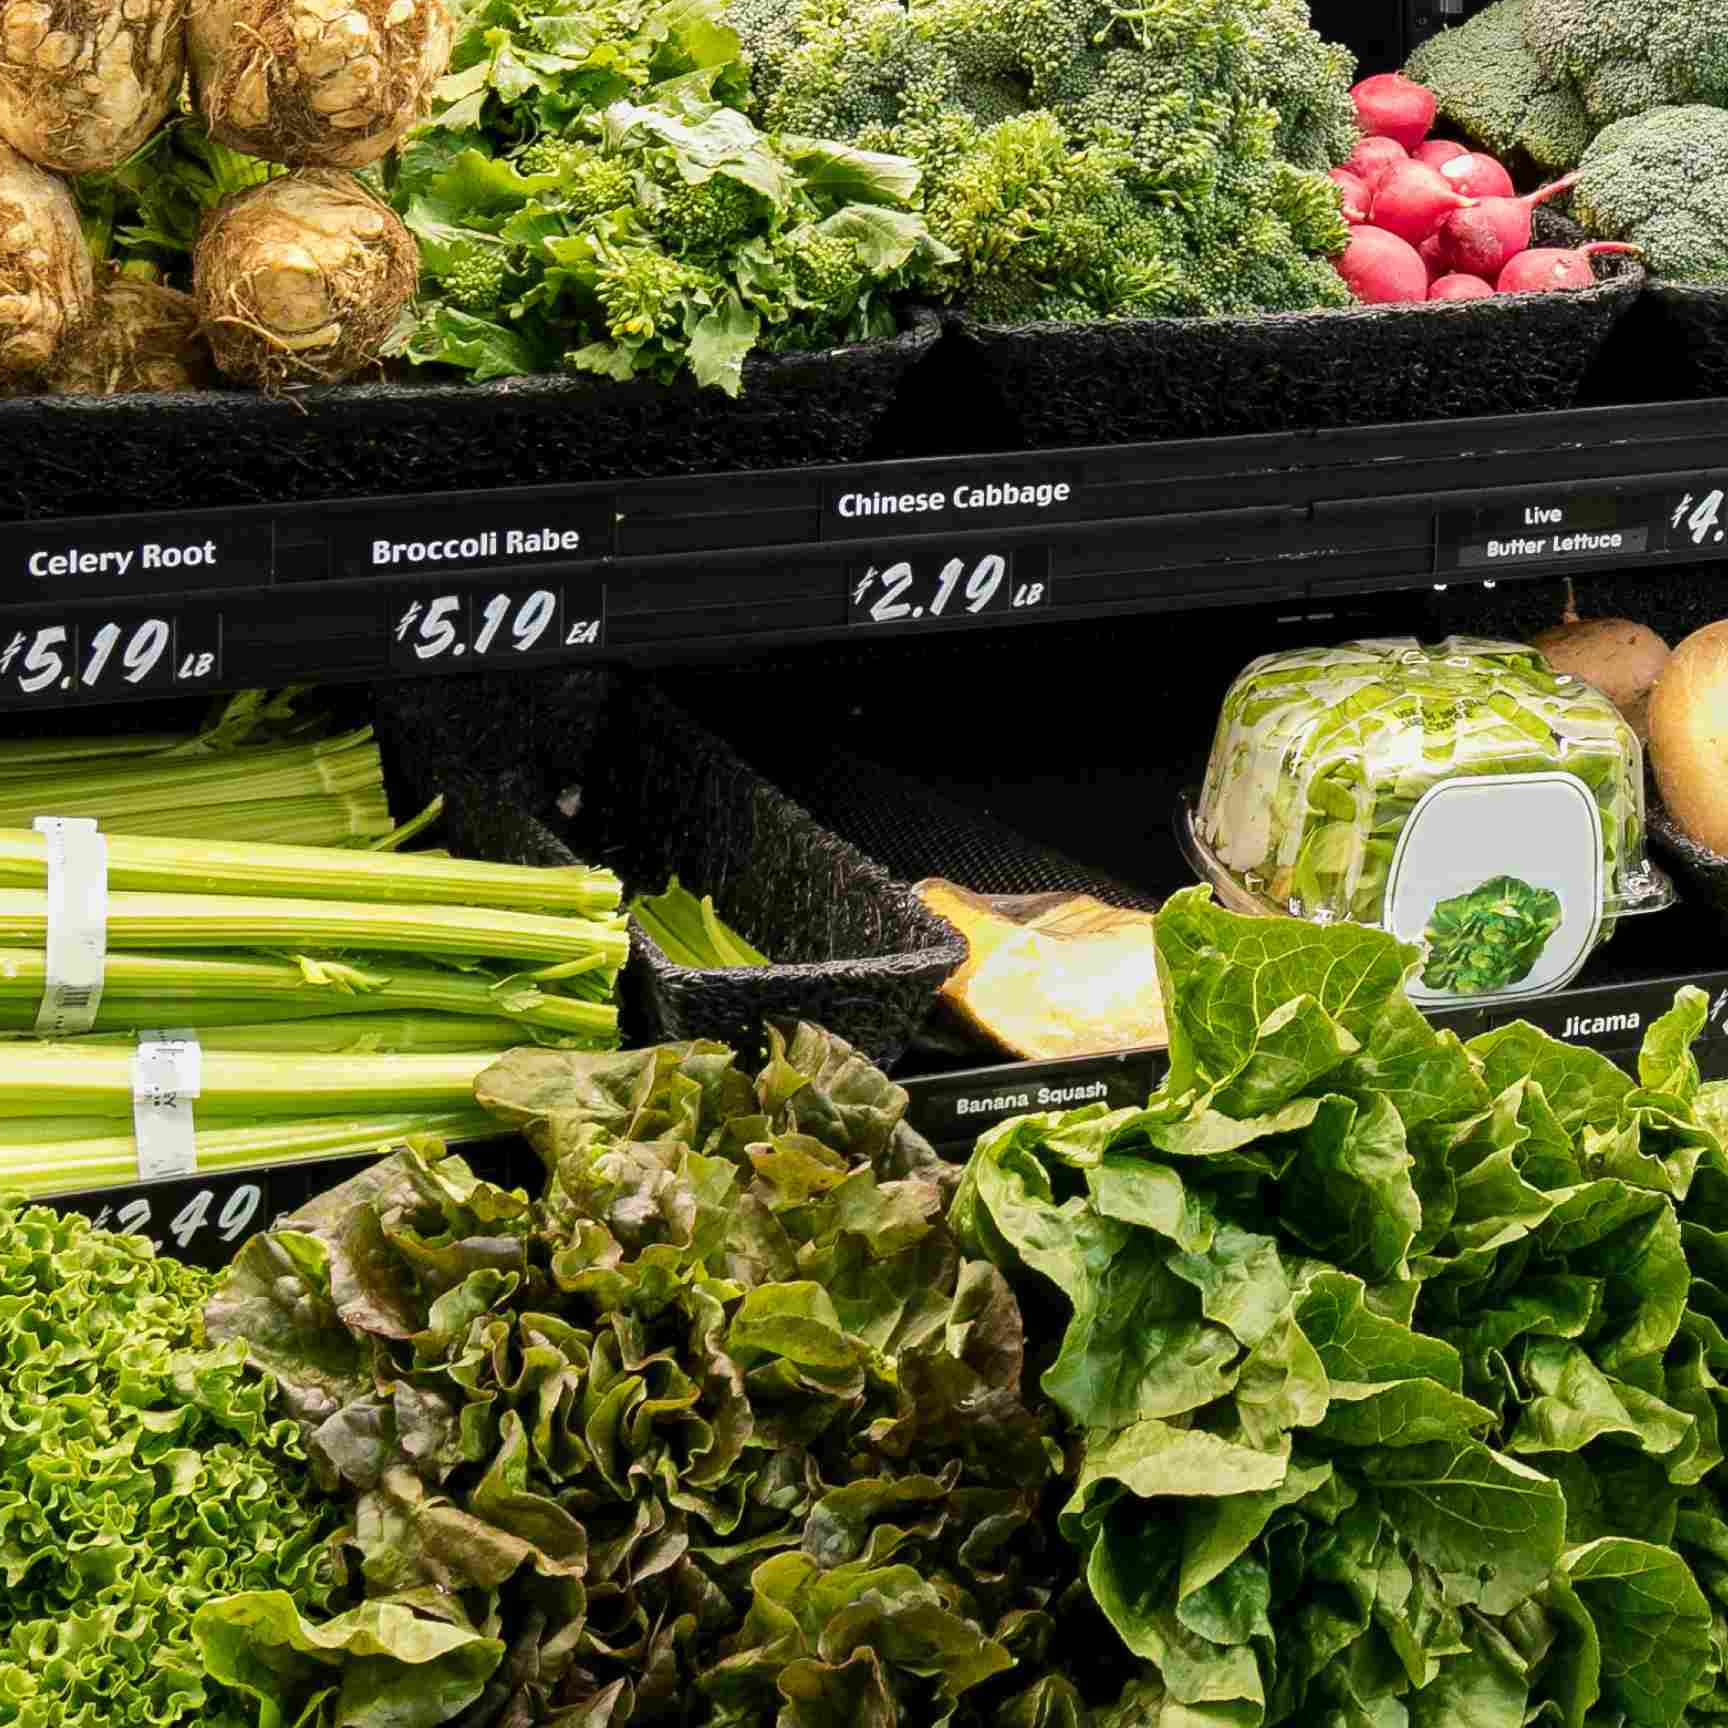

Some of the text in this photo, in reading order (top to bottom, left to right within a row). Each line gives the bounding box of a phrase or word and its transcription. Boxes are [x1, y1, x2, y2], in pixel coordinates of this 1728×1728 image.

[839, 483, 1070, 517] Chinese Cabbage
[1525, 507, 1562, 524] Live
[29, 540, 217, 578] Celery Root
[370, 528, 579, 566] Broccoli Rabe
[1487, 534, 1622, 557] Butter Lettuce
[853, 554, 1005, 622] $2.19
[395, 591, 555, 658] $5.19
[1562, 1013, 1640, 1037] Jicama
[957, 1081, 1107, 1114] Banana Squash
